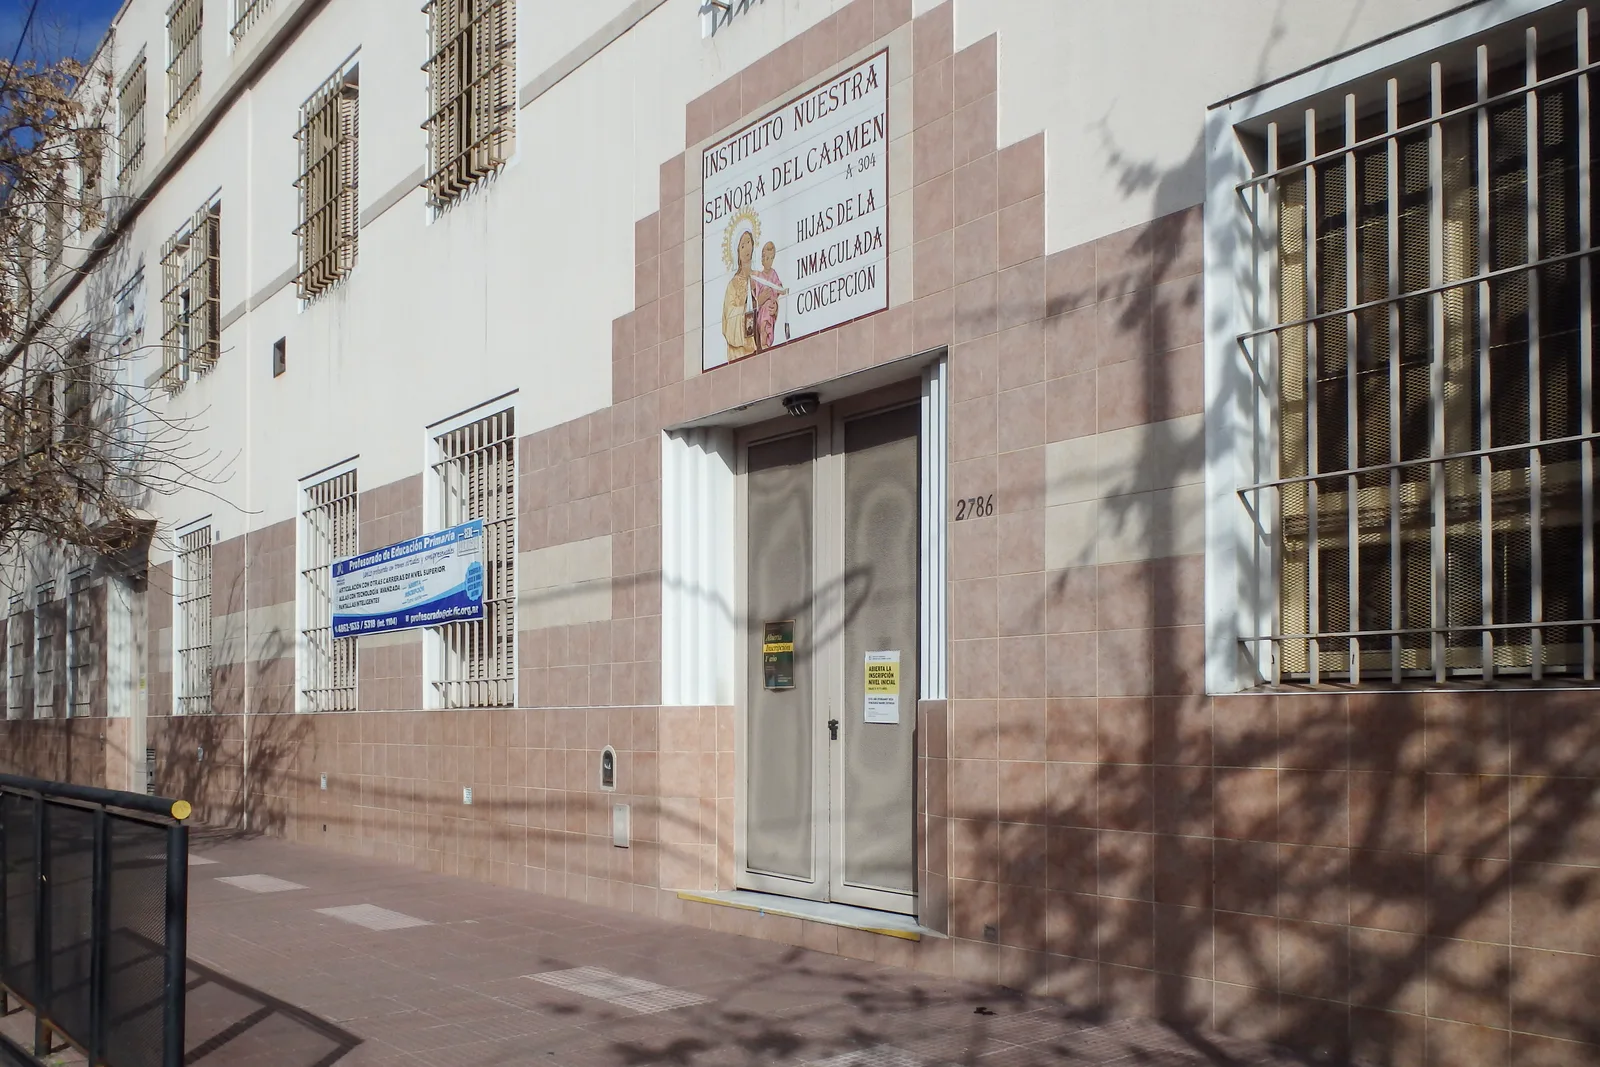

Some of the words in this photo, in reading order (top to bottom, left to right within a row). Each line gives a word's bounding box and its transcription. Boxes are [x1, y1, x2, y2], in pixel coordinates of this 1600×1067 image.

[705, 116, 783, 179] INSTITUTO
[793, 64, 879, 132] NUESTRA
[705, 174, 766, 224] SEÑORA
[772, 156, 804, 192] DEL
[806, 113, 885, 173] CARMEN
[845, 163, 853, 180] A
[858, 152, 876, 173] 304
[796, 206, 834, 243] HIJAS
[837, 198, 854, 226] DE
[857, 188, 876, 218] LA
[796, 226, 883, 280] INMACULADA
[955, 493, 993, 521] 2786
[349, 552, 382, 571] Profesorado
[383, 549, 390, 561] de
[391, 540, 423, 559] Educación
[424, 530, 456, 549] Primaria
[423, 565, 446, 576] SUPERIOR
